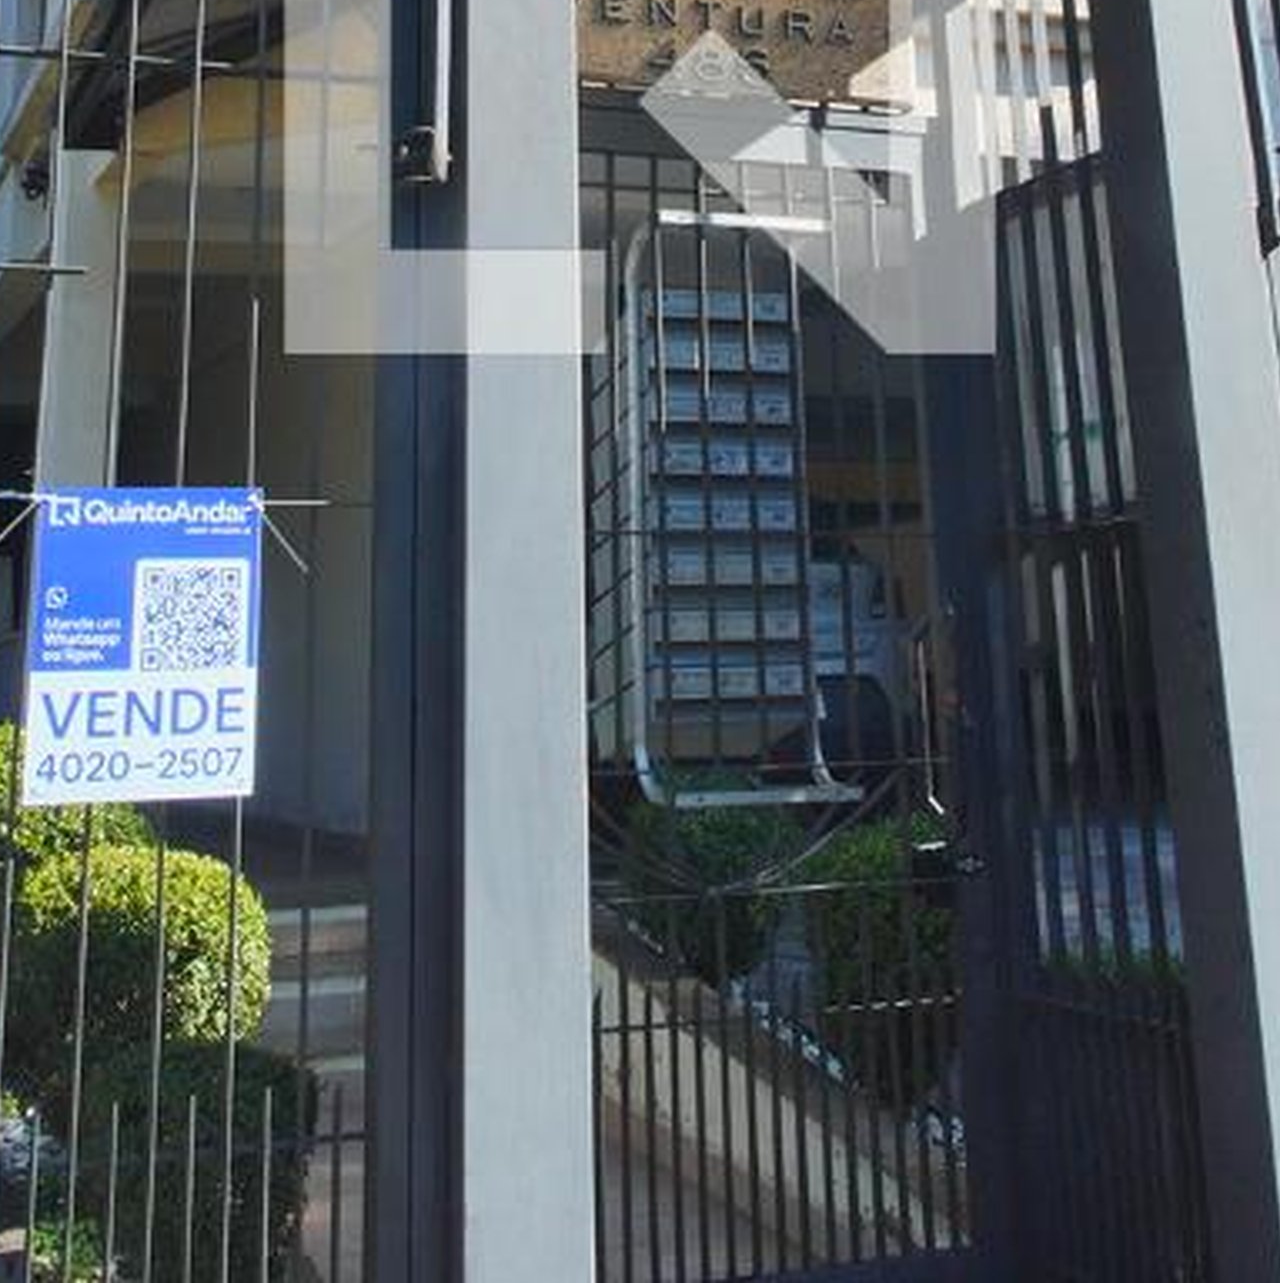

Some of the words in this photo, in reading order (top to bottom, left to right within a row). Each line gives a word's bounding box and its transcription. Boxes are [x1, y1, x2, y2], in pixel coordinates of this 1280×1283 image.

[84, 497, 252, 525] QuintoAndar
[41, 688, 245, 739] VENDE
[36, 747, 243, 784] 4020-2507
